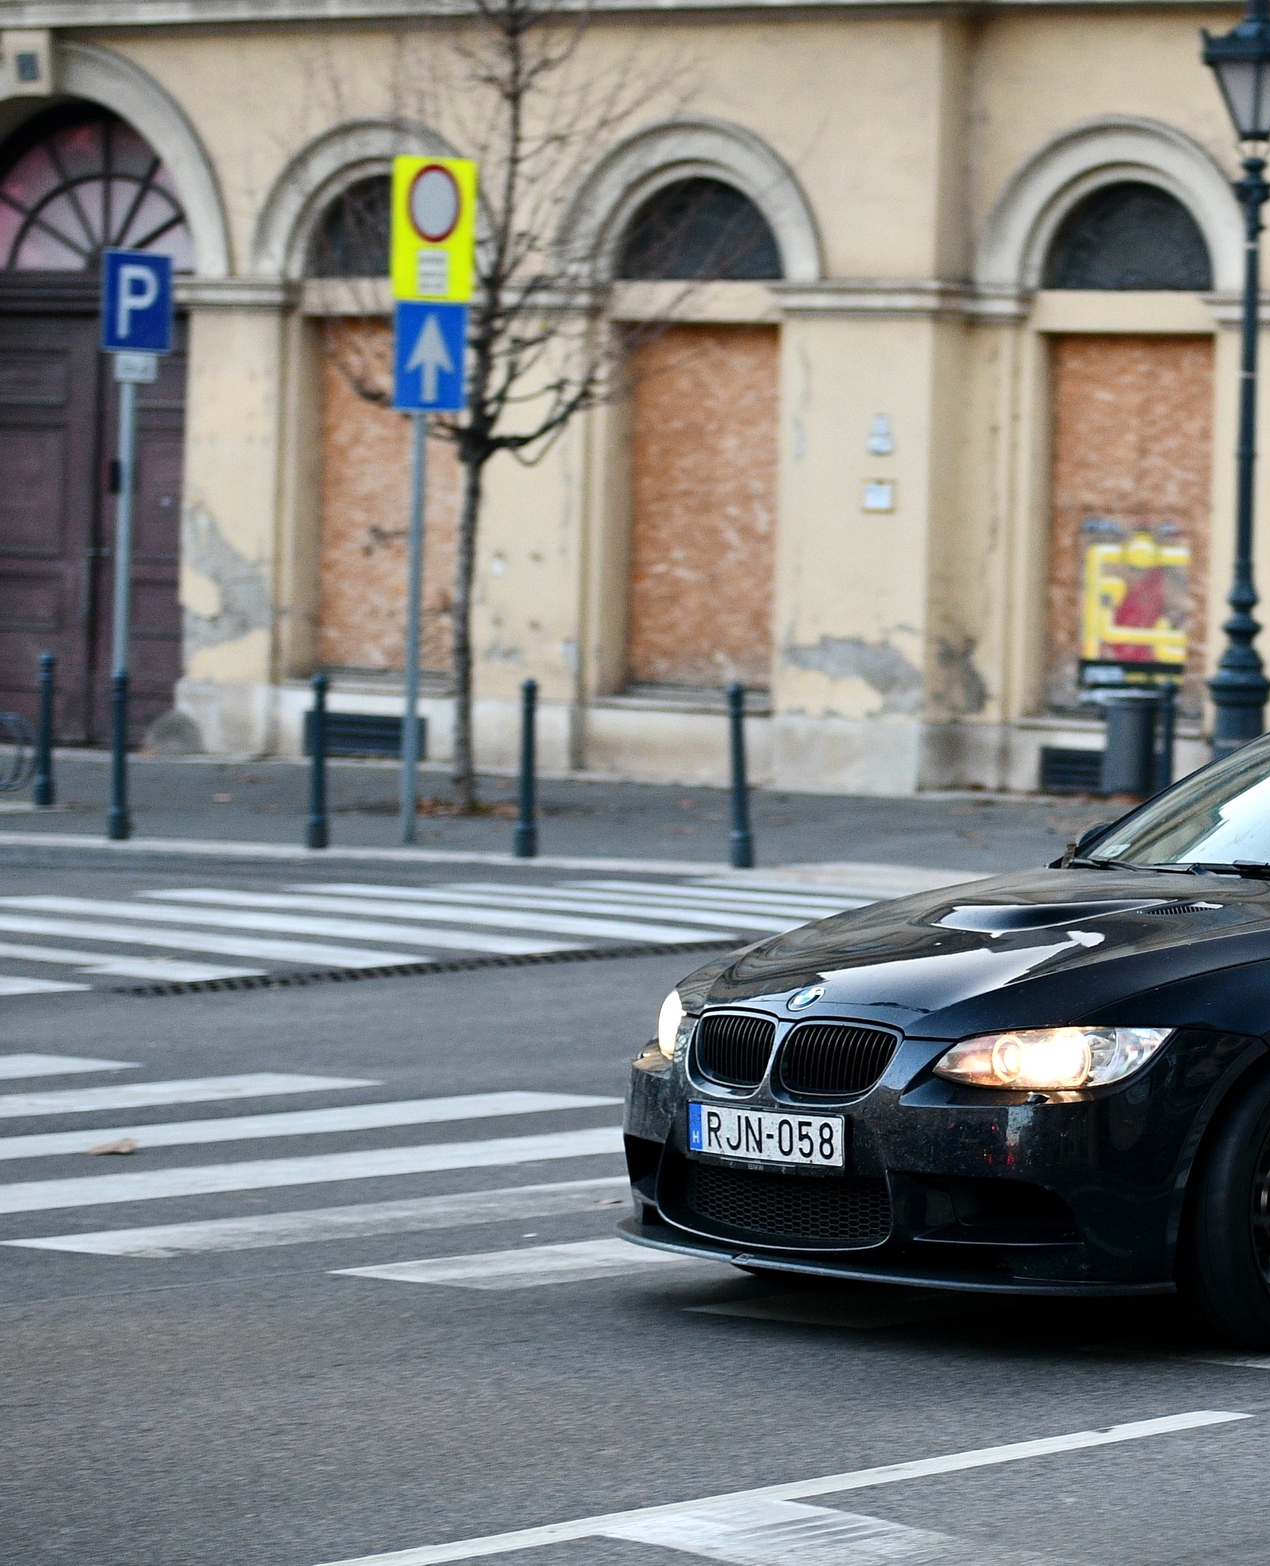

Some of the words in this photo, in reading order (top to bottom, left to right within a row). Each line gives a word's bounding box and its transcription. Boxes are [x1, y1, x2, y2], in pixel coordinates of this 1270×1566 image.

[117, 264, 158, 339] P
[692, 1130, 700, 1144] H
[707, 1111, 834, 1160] RJN-058
